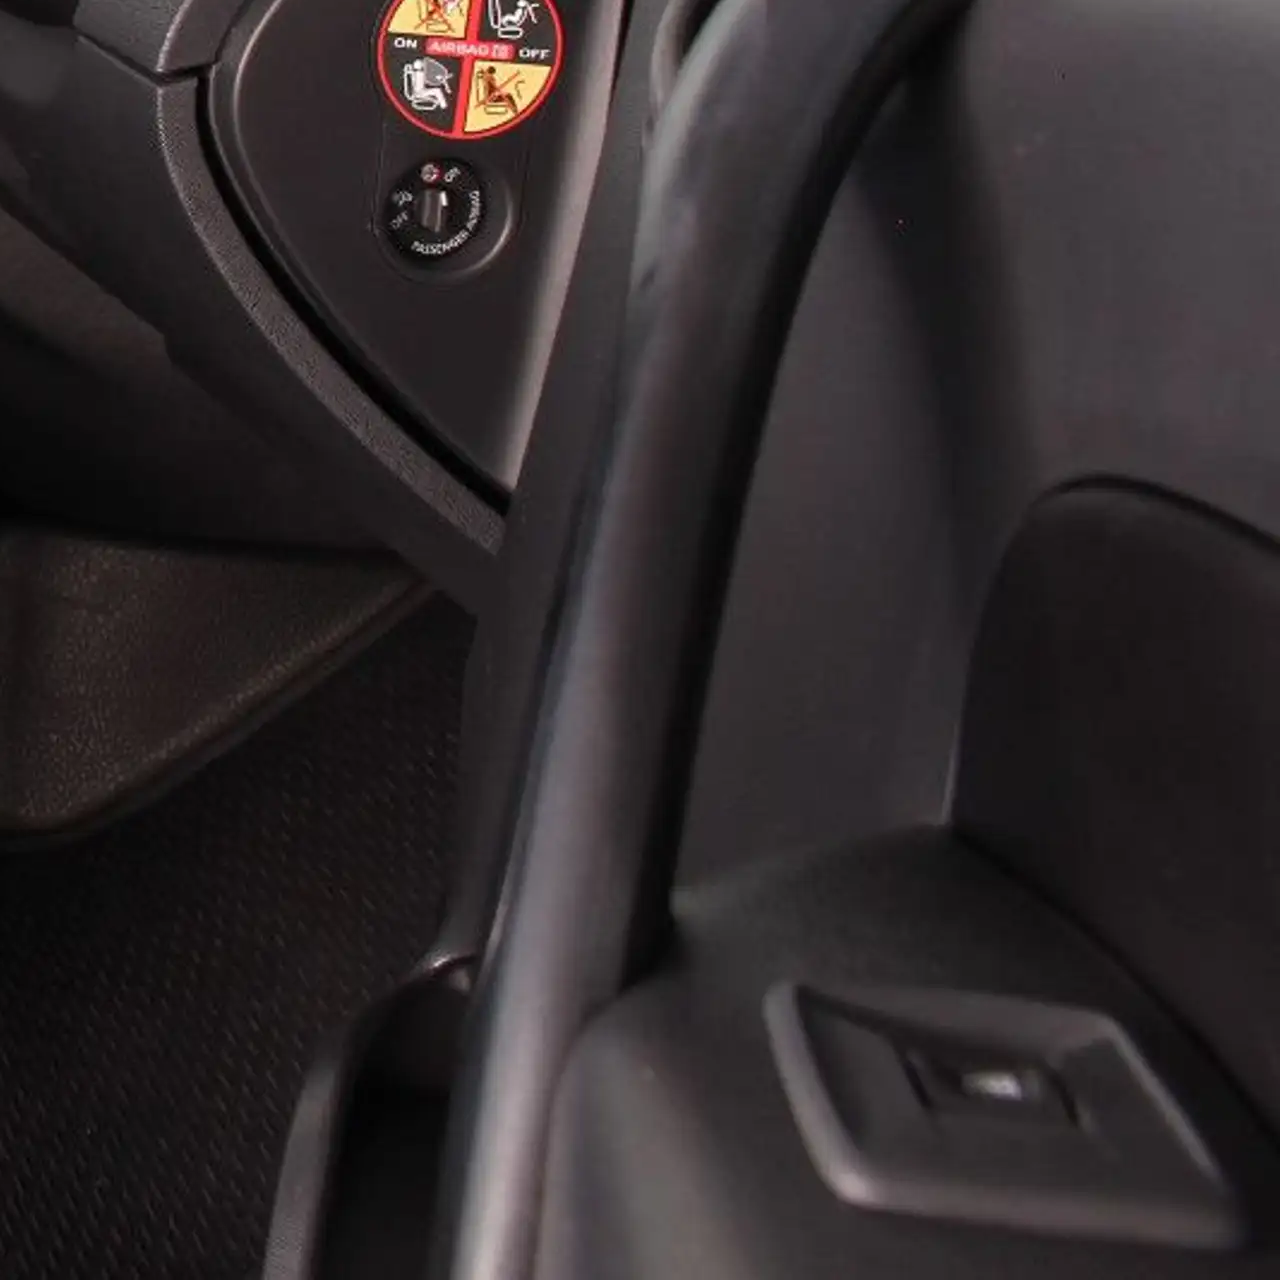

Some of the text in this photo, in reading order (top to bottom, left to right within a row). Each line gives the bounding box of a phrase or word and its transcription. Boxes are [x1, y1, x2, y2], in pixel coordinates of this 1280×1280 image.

[394, 36, 418, 49] ON
[428, 41, 489, 56] AIRBAG
[518, 47, 552, 60] OFF
